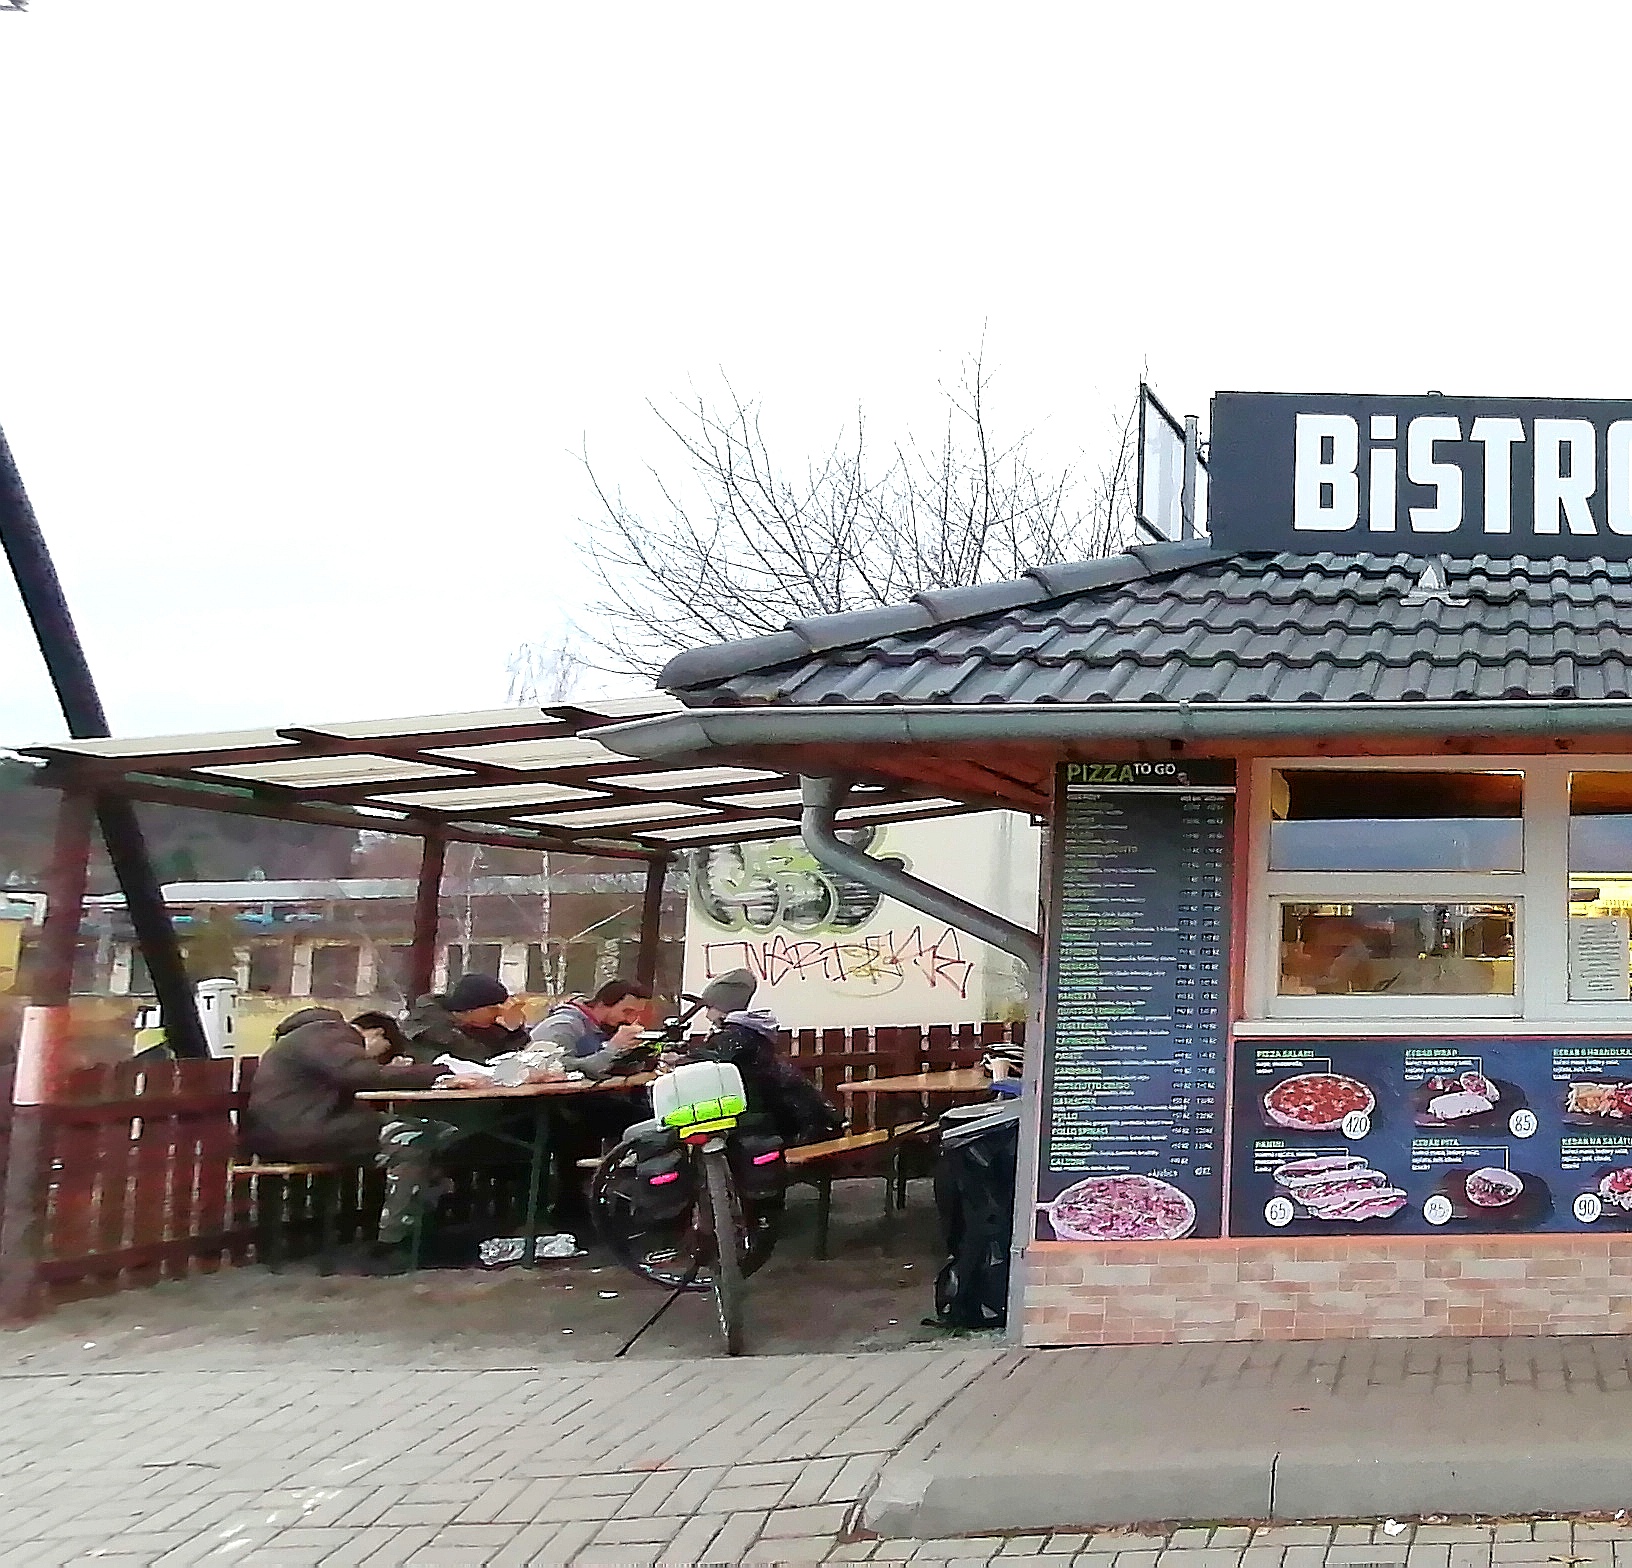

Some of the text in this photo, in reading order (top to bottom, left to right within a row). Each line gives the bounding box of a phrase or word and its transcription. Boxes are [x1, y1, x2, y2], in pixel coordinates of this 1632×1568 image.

[1067, 763, 1176, 783] PIZZA TO GO
